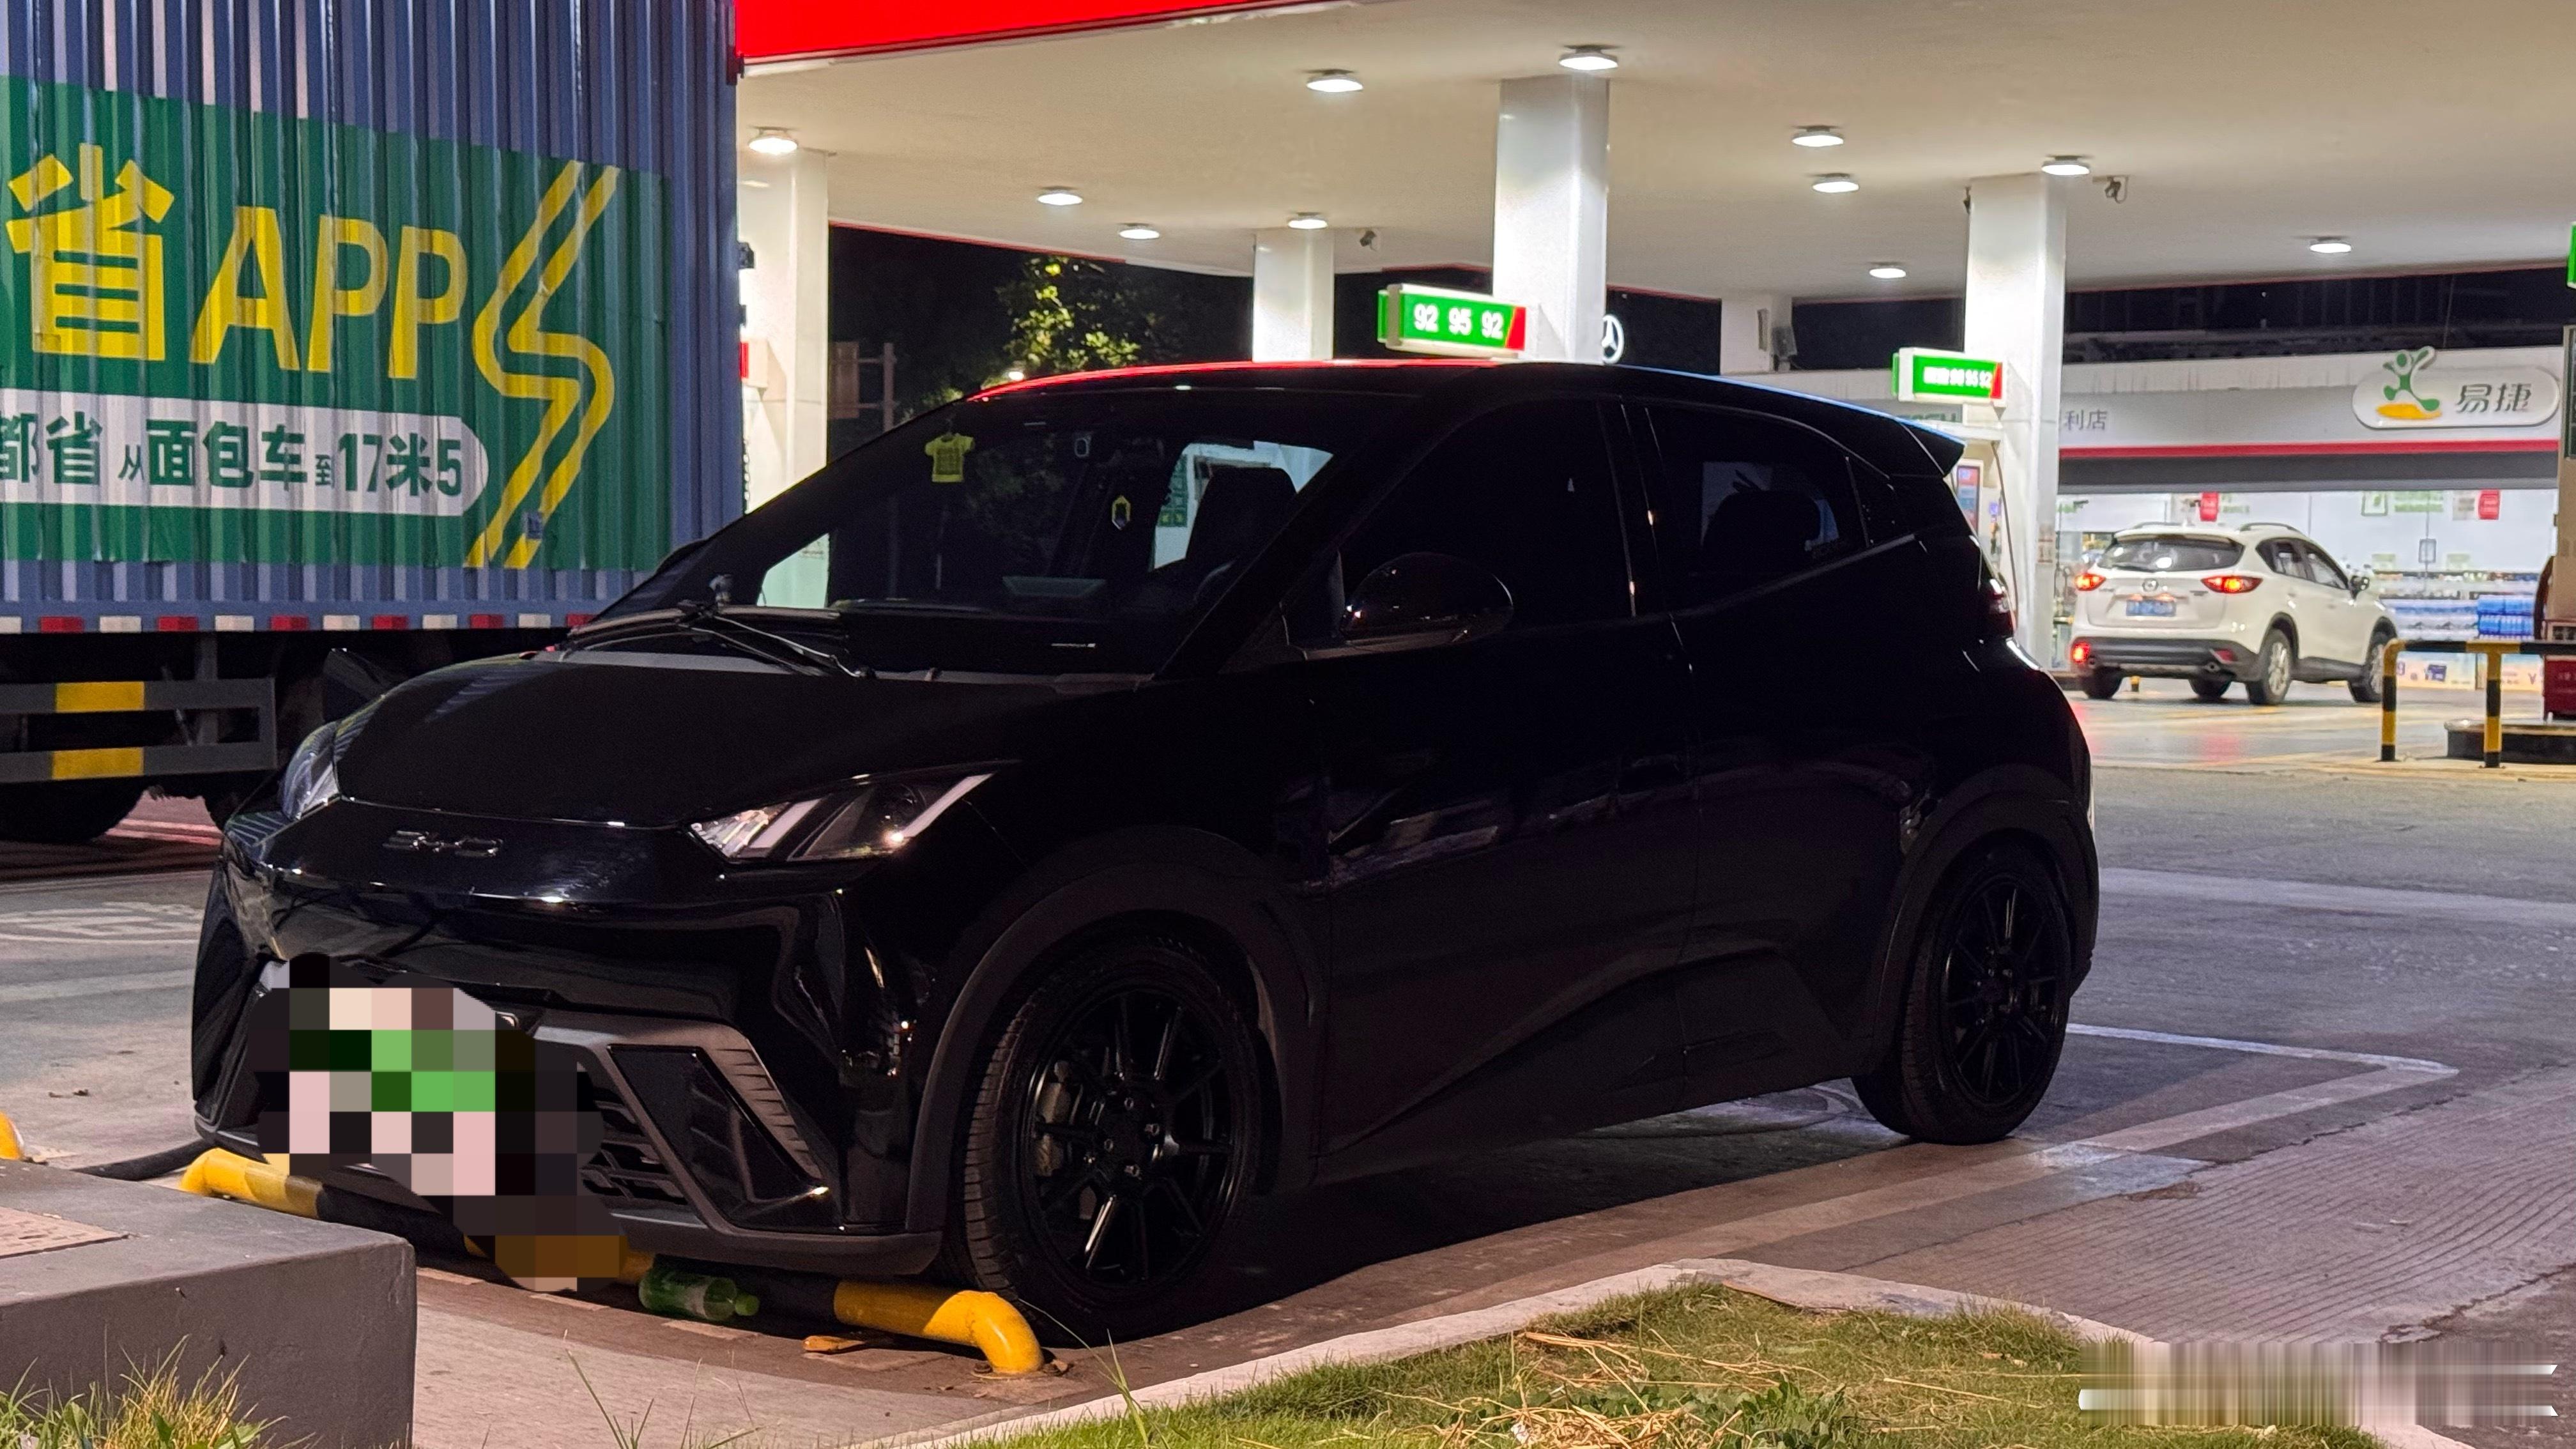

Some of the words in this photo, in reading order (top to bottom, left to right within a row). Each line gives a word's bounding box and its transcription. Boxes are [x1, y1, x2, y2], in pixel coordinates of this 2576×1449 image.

[1413, 303, 1439, 332] 92
[1448, 307, 1472, 335] 95
[1482, 310, 1504, 339] 92
[2456, 382, 2533, 414] 易捷
